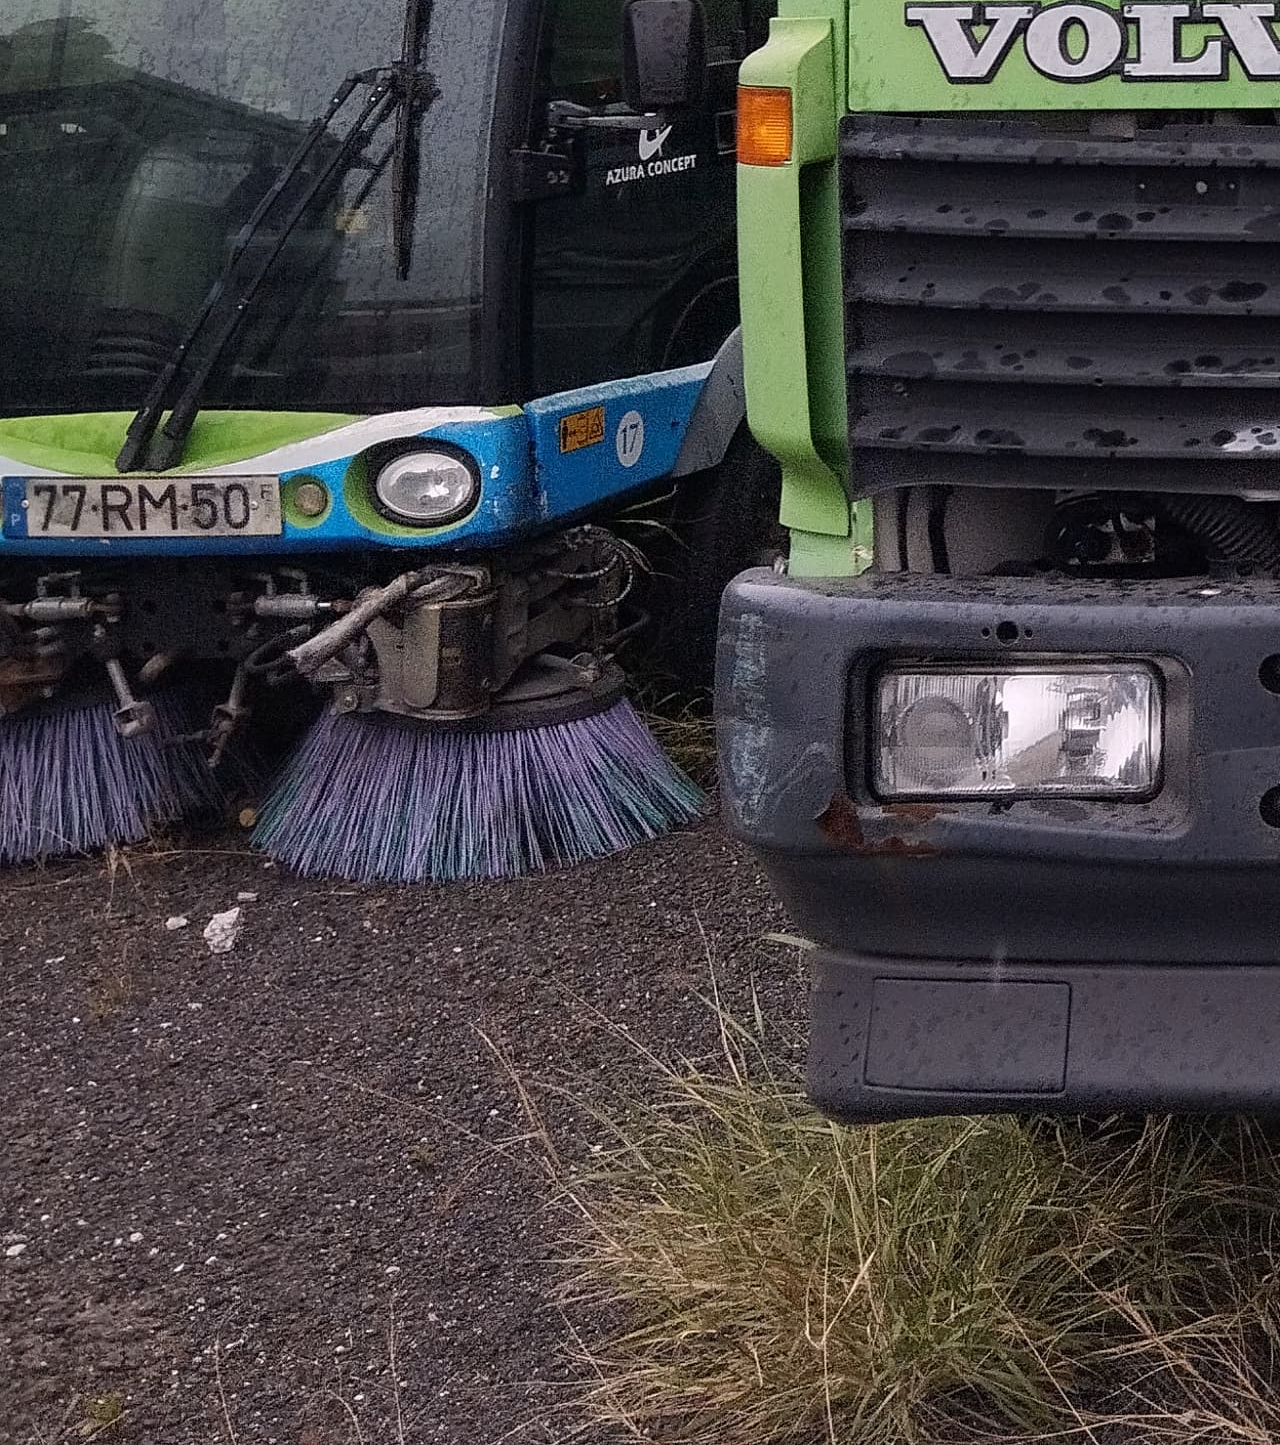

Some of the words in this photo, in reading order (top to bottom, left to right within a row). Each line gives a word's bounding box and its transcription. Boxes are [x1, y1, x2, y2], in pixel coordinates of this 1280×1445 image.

[605, 164, 645, 186] AZURA
[647, 154, 697, 177] CONCEPT
[620, 421, 640, 454] 17
[11, 513, 21, 527] P
